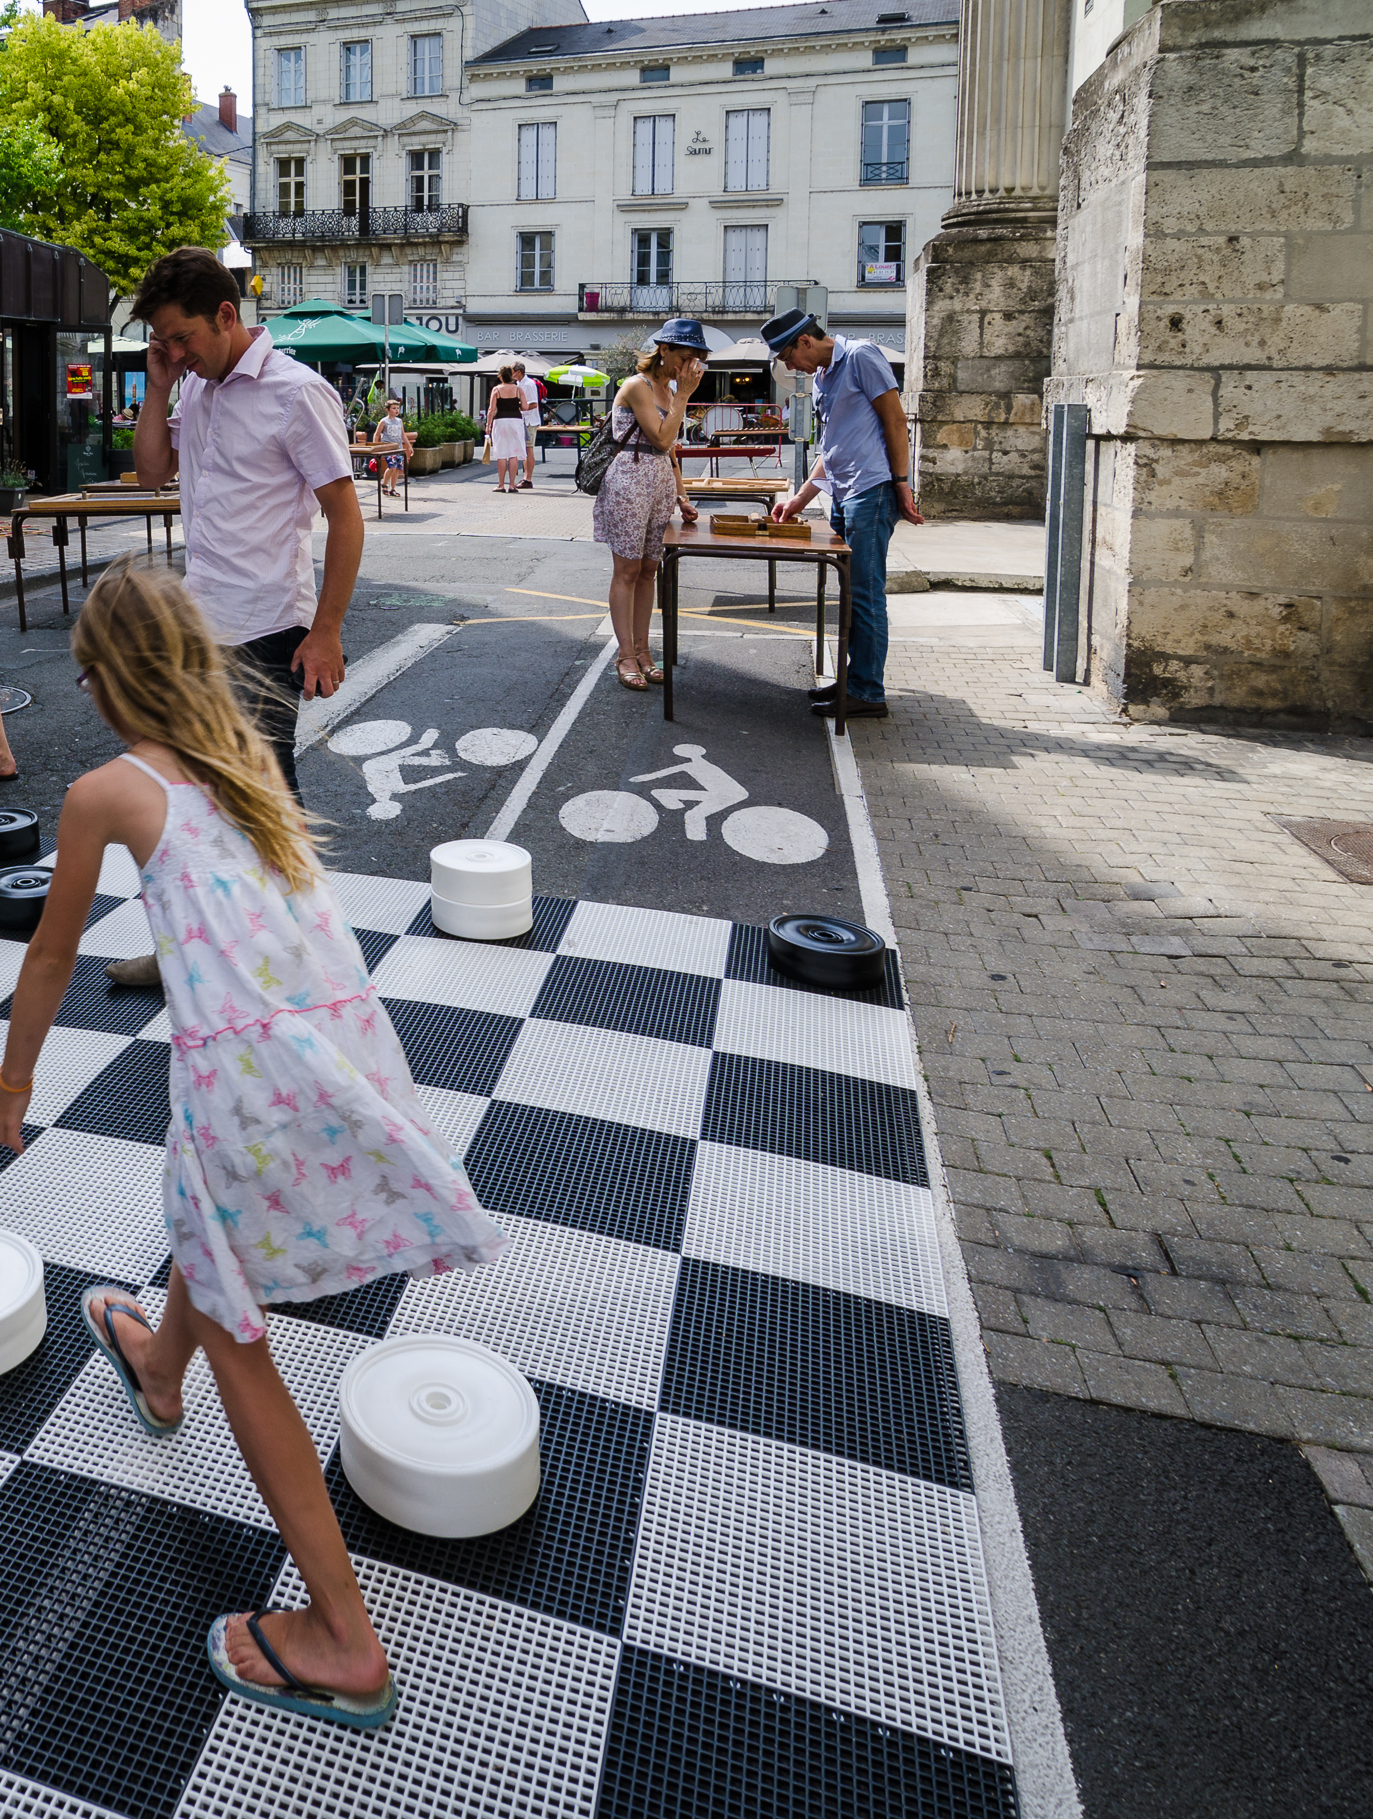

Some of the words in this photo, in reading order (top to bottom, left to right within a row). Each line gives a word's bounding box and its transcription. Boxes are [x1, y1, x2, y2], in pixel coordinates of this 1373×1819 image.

[477, 331, 500, 342] BAR
[509, 331, 568, 342] BRASSERIE
[868, 332, 906, 344] BRAS
